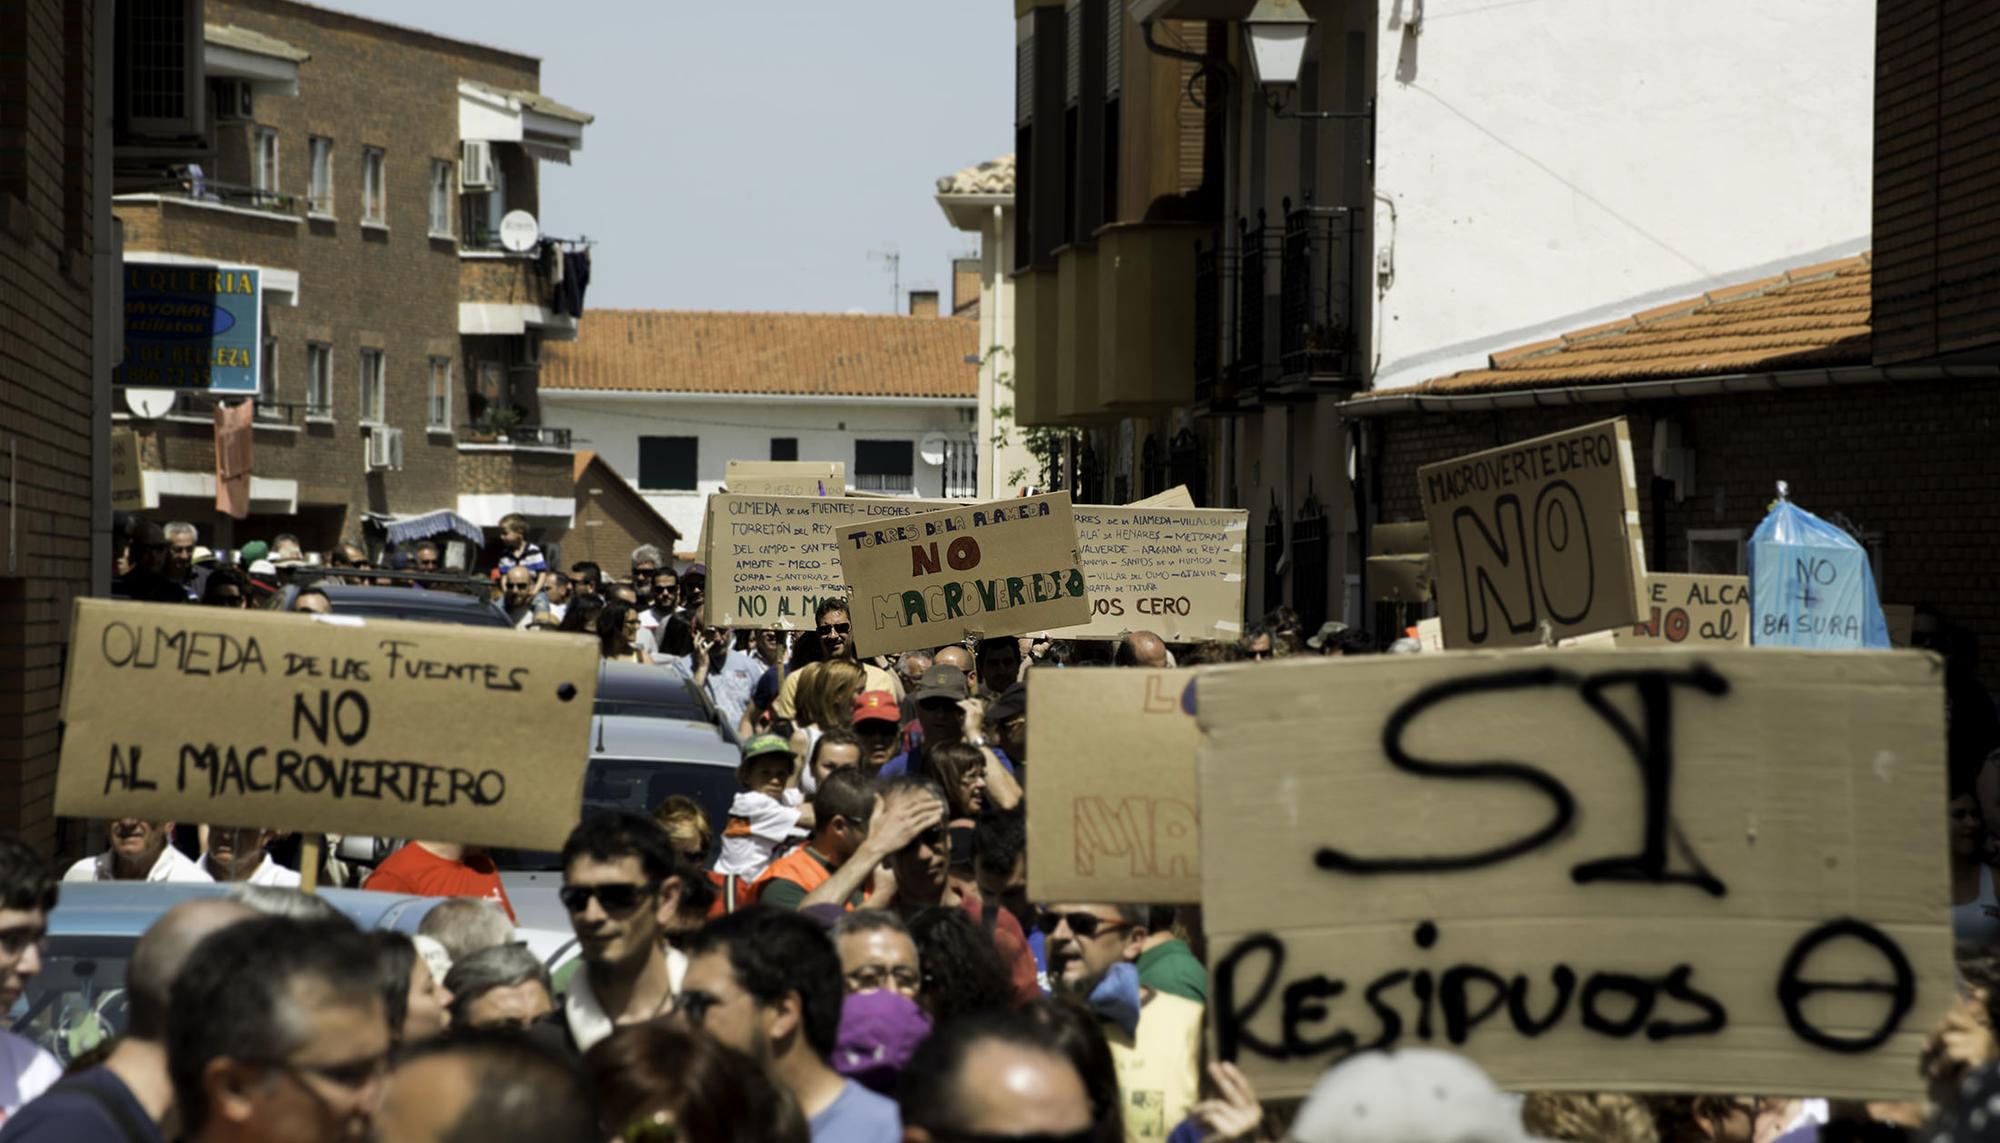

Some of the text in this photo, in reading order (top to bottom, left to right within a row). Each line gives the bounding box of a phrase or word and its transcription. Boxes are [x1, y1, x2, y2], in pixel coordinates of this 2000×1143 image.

[172, 345, 251, 368] BELLEZA
[1427, 433, 1613, 504] MACROVERTEDERO
[728, 501, 782, 516] OLMEDA
[811, 502, 855, 515] FUENTES
[867, 504, 911, 516] LOECHES
[811, 522, 833, 536] REY
[848, 524, 921, 550] TORRES
[973, 501, 1050, 528] ALAMEDA
[1115, 529, 1161, 542] HENARES
[733, 543, 754, 555] DEL
[759, 543, 789, 555] CAMPO
[800, 543, 819, 553] SAN
[911, 535, 982, 578] NO
[1201, 544, 1221, 555] REY
[736, 559, 774, 570] AMBITE
[788, 559, 821, 570] MECO
[1121, 558, 1154, 567] SANTOS
[1453, 479, 1595, 645] NO
[1796, 556, 1837, 585] NO
[733, 572, 766, 582] CORPA
[738, 594, 768, 618] NO
[777, 595, 797, 617] AL
[1136, 595, 1191, 617] CERO
[1633, 607, 1690, 643] NO
[1763, 613, 1860, 640] BASURA
[102, 621, 530, 693] OLMEDA DE LAS FUENTES
[293, 688, 370, 748] NO
[104, 741, 507, 808] AL MACROVERTERO
[1312, 660, 1732, 901] SI
